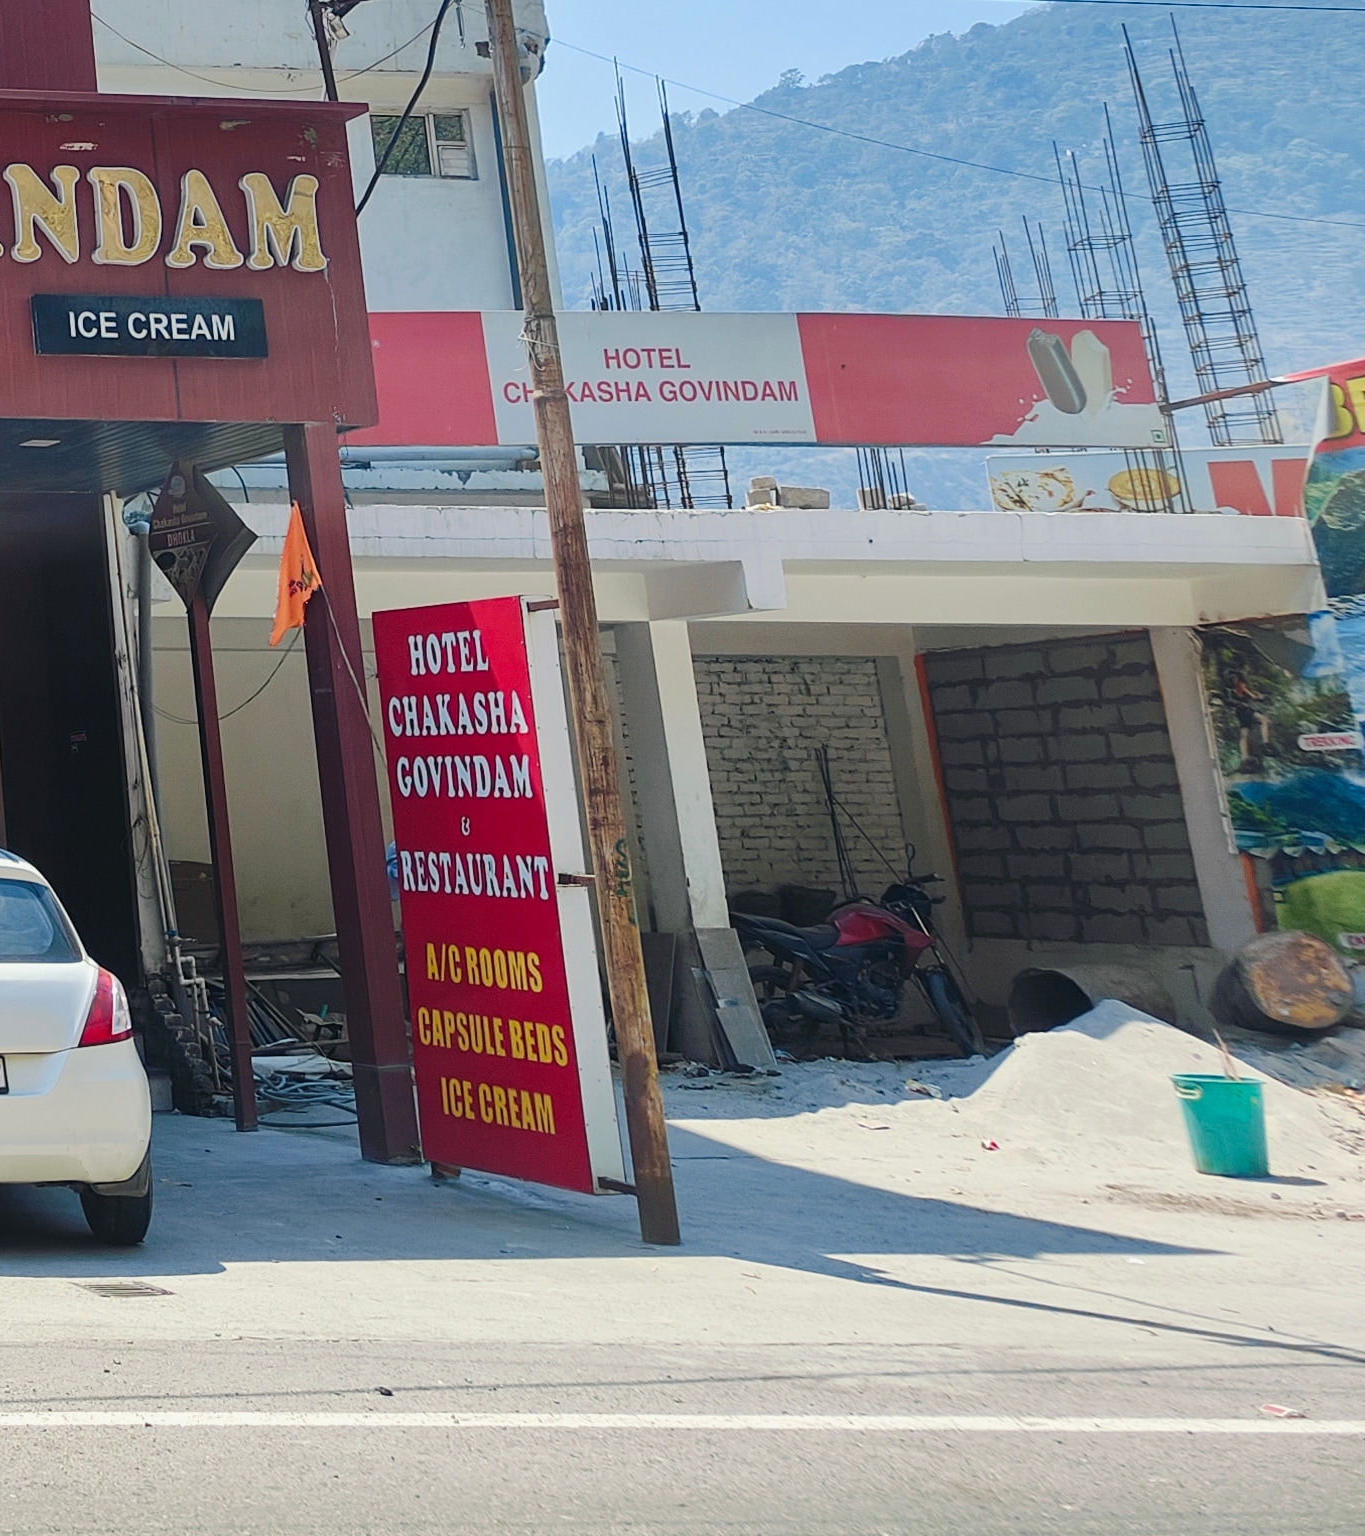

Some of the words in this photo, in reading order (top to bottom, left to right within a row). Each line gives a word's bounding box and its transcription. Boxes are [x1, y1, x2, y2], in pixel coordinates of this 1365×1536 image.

[69, 310, 119, 340] ICE
[127, 312, 236, 343] CREAM
[603, 348, 691, 369] HOTEL
[503, 380, 652, 404] CHKASHA
[658, 380, 799, 403] GOVINDAM
[407, 629, 489, 676] HOTEL
[388, 689, 529, 738] CHAKASHA
[396, 754, 533, 800] GOVINDAM
[399, 849, 549, 901] RESTAURANT
[426, 942, 462, 984] A/C
[465, 946, 543, 994] ROOMS
[417, 1006, 504, 1057] CAPSULE
[510, 1018, 568, 1067] BEDS
[440, 1076, 473, 1120] ICE
[477, 1081, 556, 1135] CREAM
